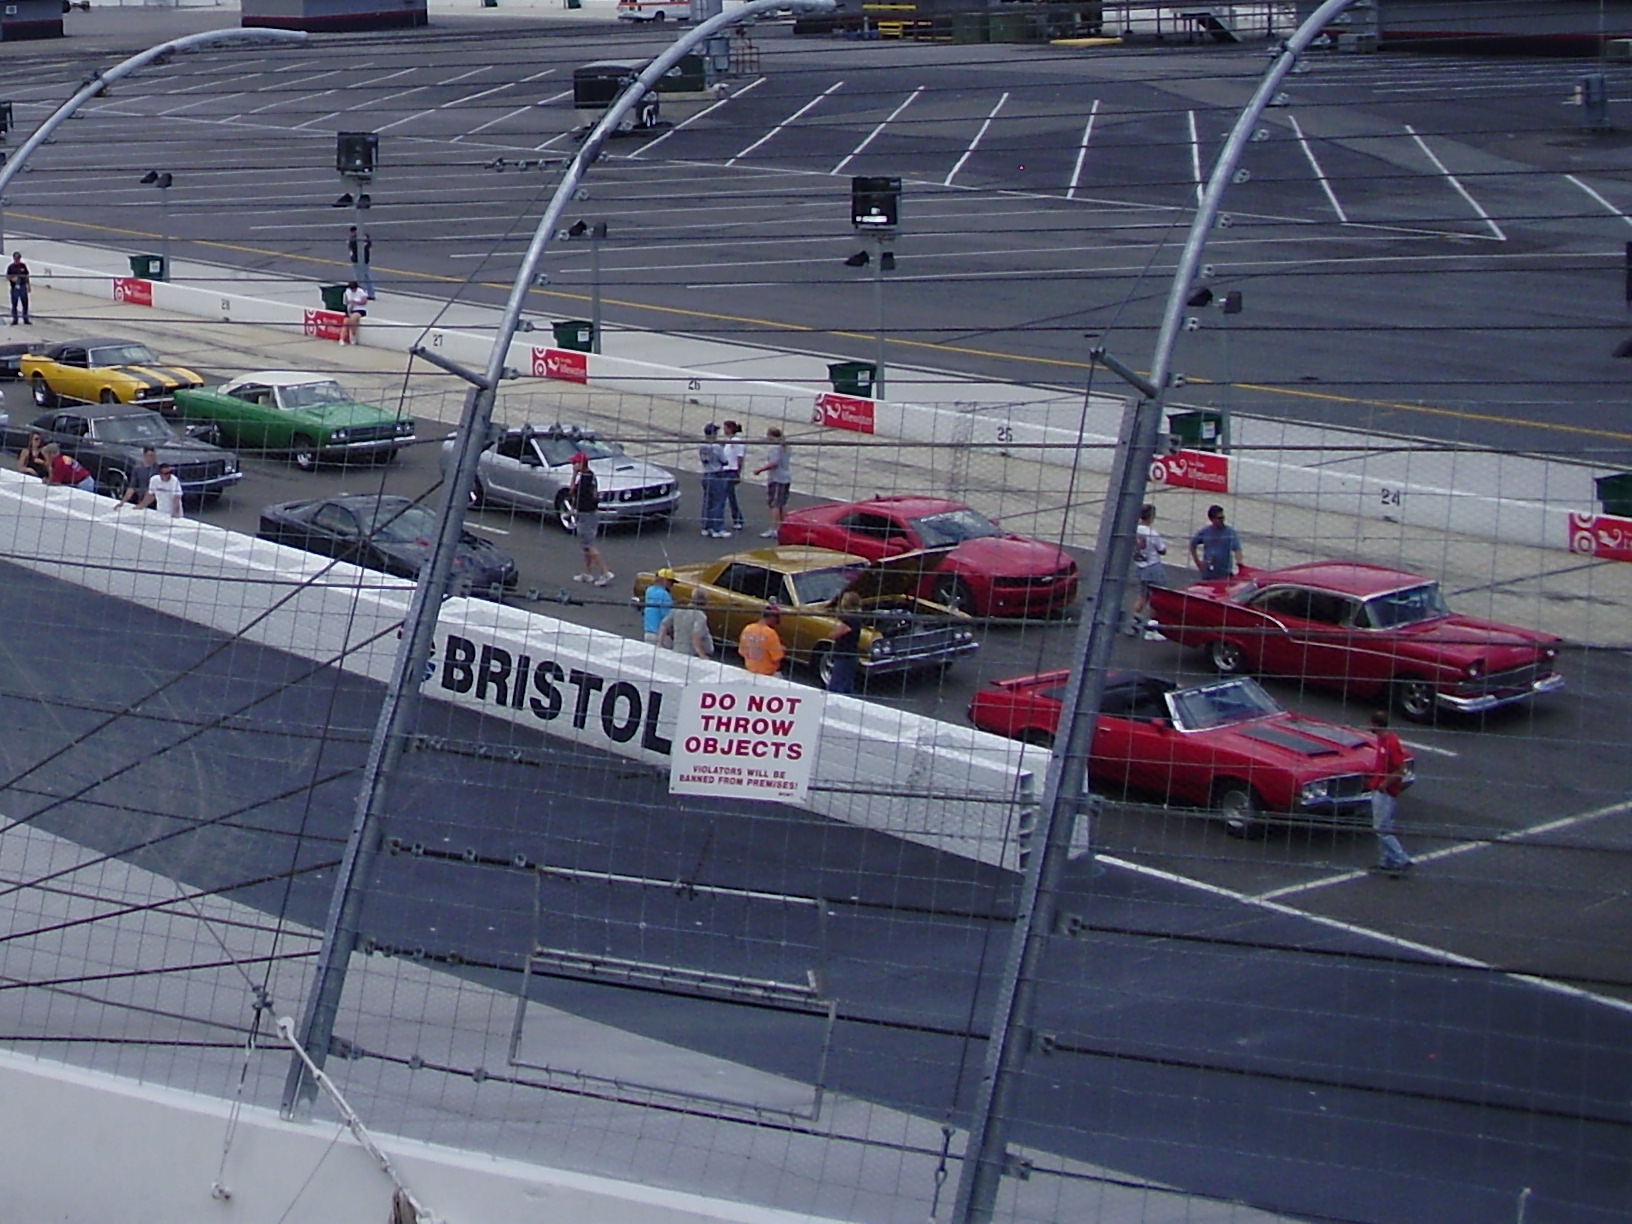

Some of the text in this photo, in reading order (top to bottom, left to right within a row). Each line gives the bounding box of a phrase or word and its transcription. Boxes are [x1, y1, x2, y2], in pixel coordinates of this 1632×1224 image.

[433, 333, 444, 347] 27
[997, 426, 1013, 442] 25
[1381, 487, 1400, 506] 24
[441, 634, 673, 755] BRISTOL
[700, 692, 803, 715] DO NOT
[700, 714, 795, 737] THROW
[684, 736, 804, 761] OBJECTS
[693, 765, 786, 779] VIOLATORS WILL BE
[679, 774, 798, 790] BANNED FROM PREMISES!
